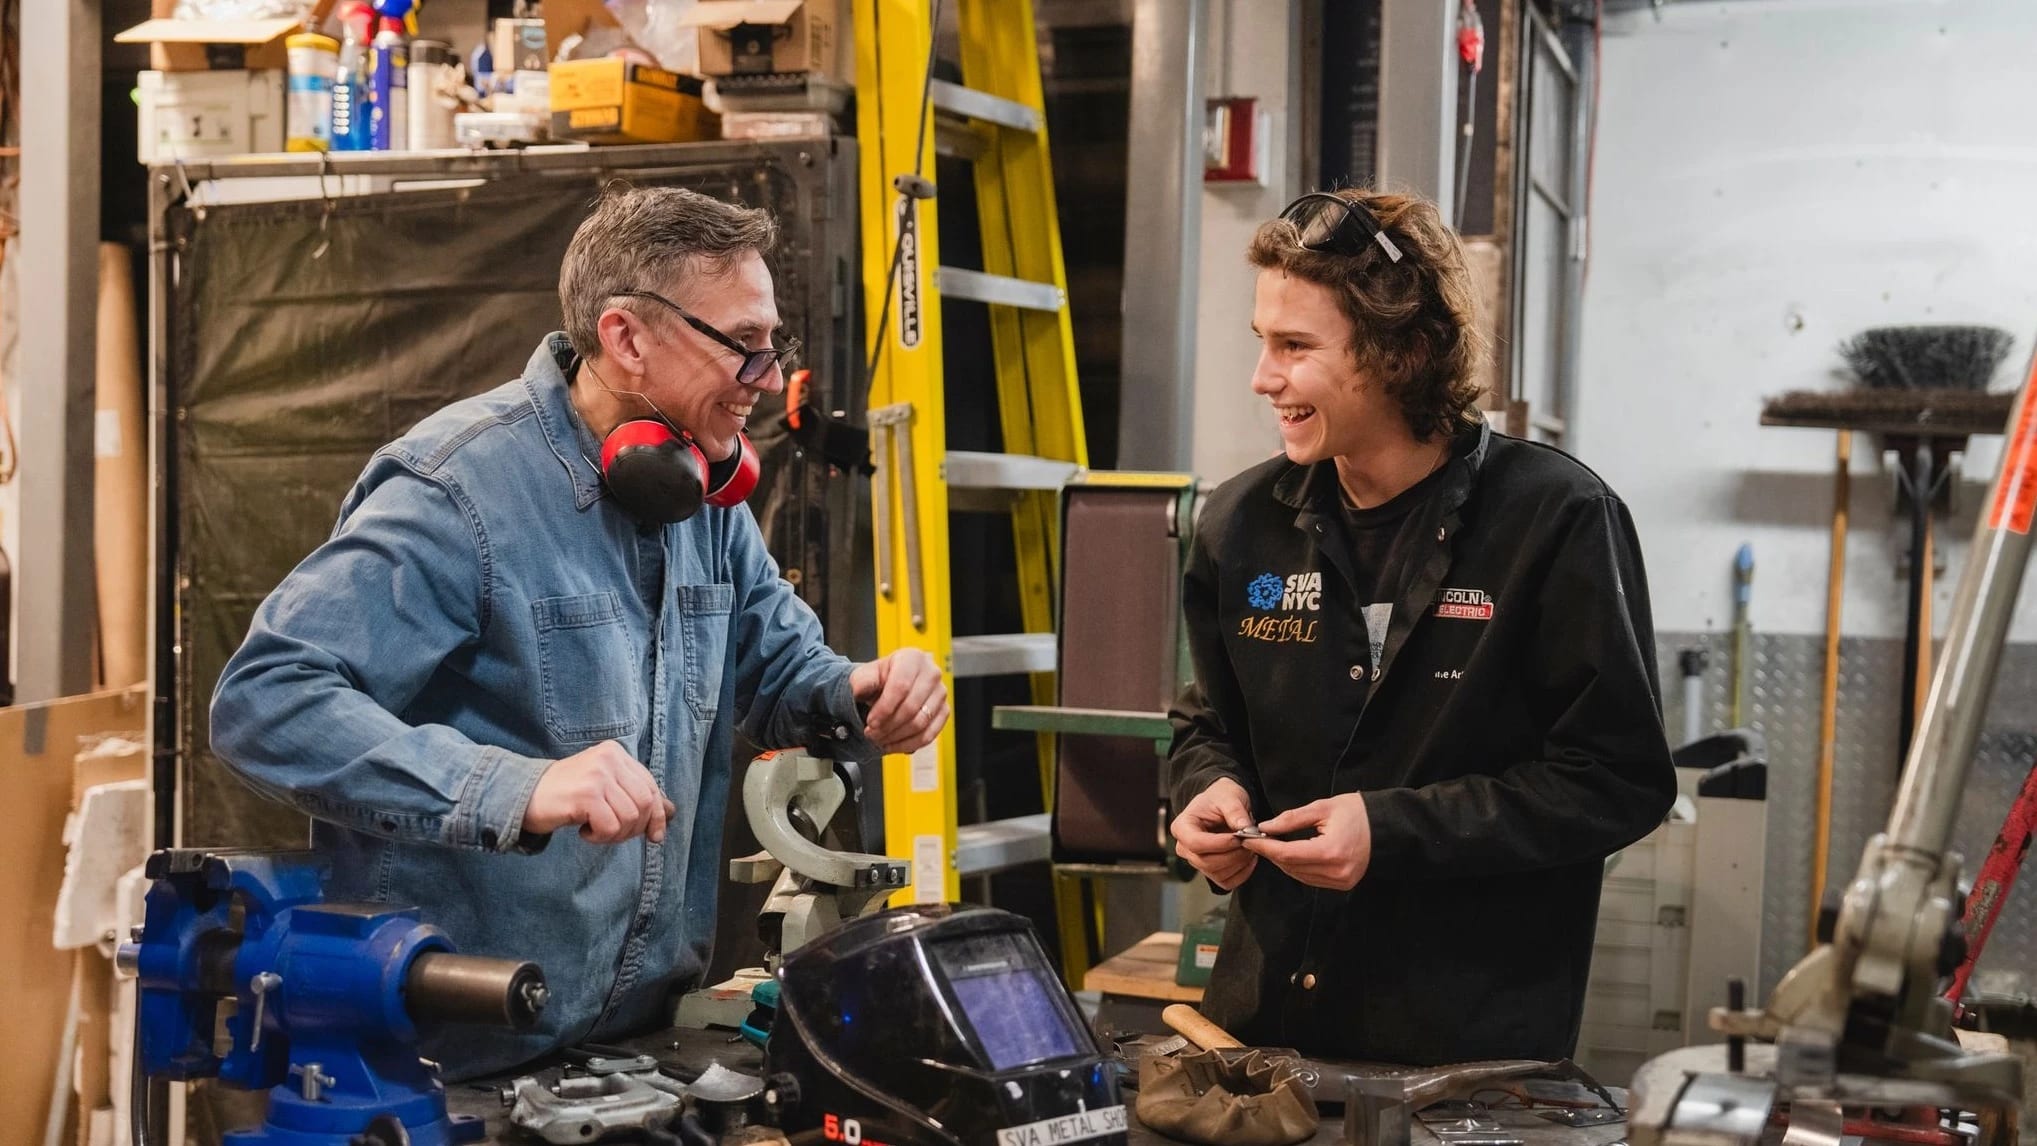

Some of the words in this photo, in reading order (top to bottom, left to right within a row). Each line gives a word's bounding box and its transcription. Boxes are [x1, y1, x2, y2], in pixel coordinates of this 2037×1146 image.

[902, 220, 917, 346] OUISVILLE
[1284, 572, 1322, 593] SVA
[1282, 592, 1321, 611] NYC
[1238, 615, 1318, 642] METAL
[824, 1113, 861, 1146] 5.0
[1005, 1127, 1041, 1146] SVA
[1047, 1114, 1097, 1143] METAL
